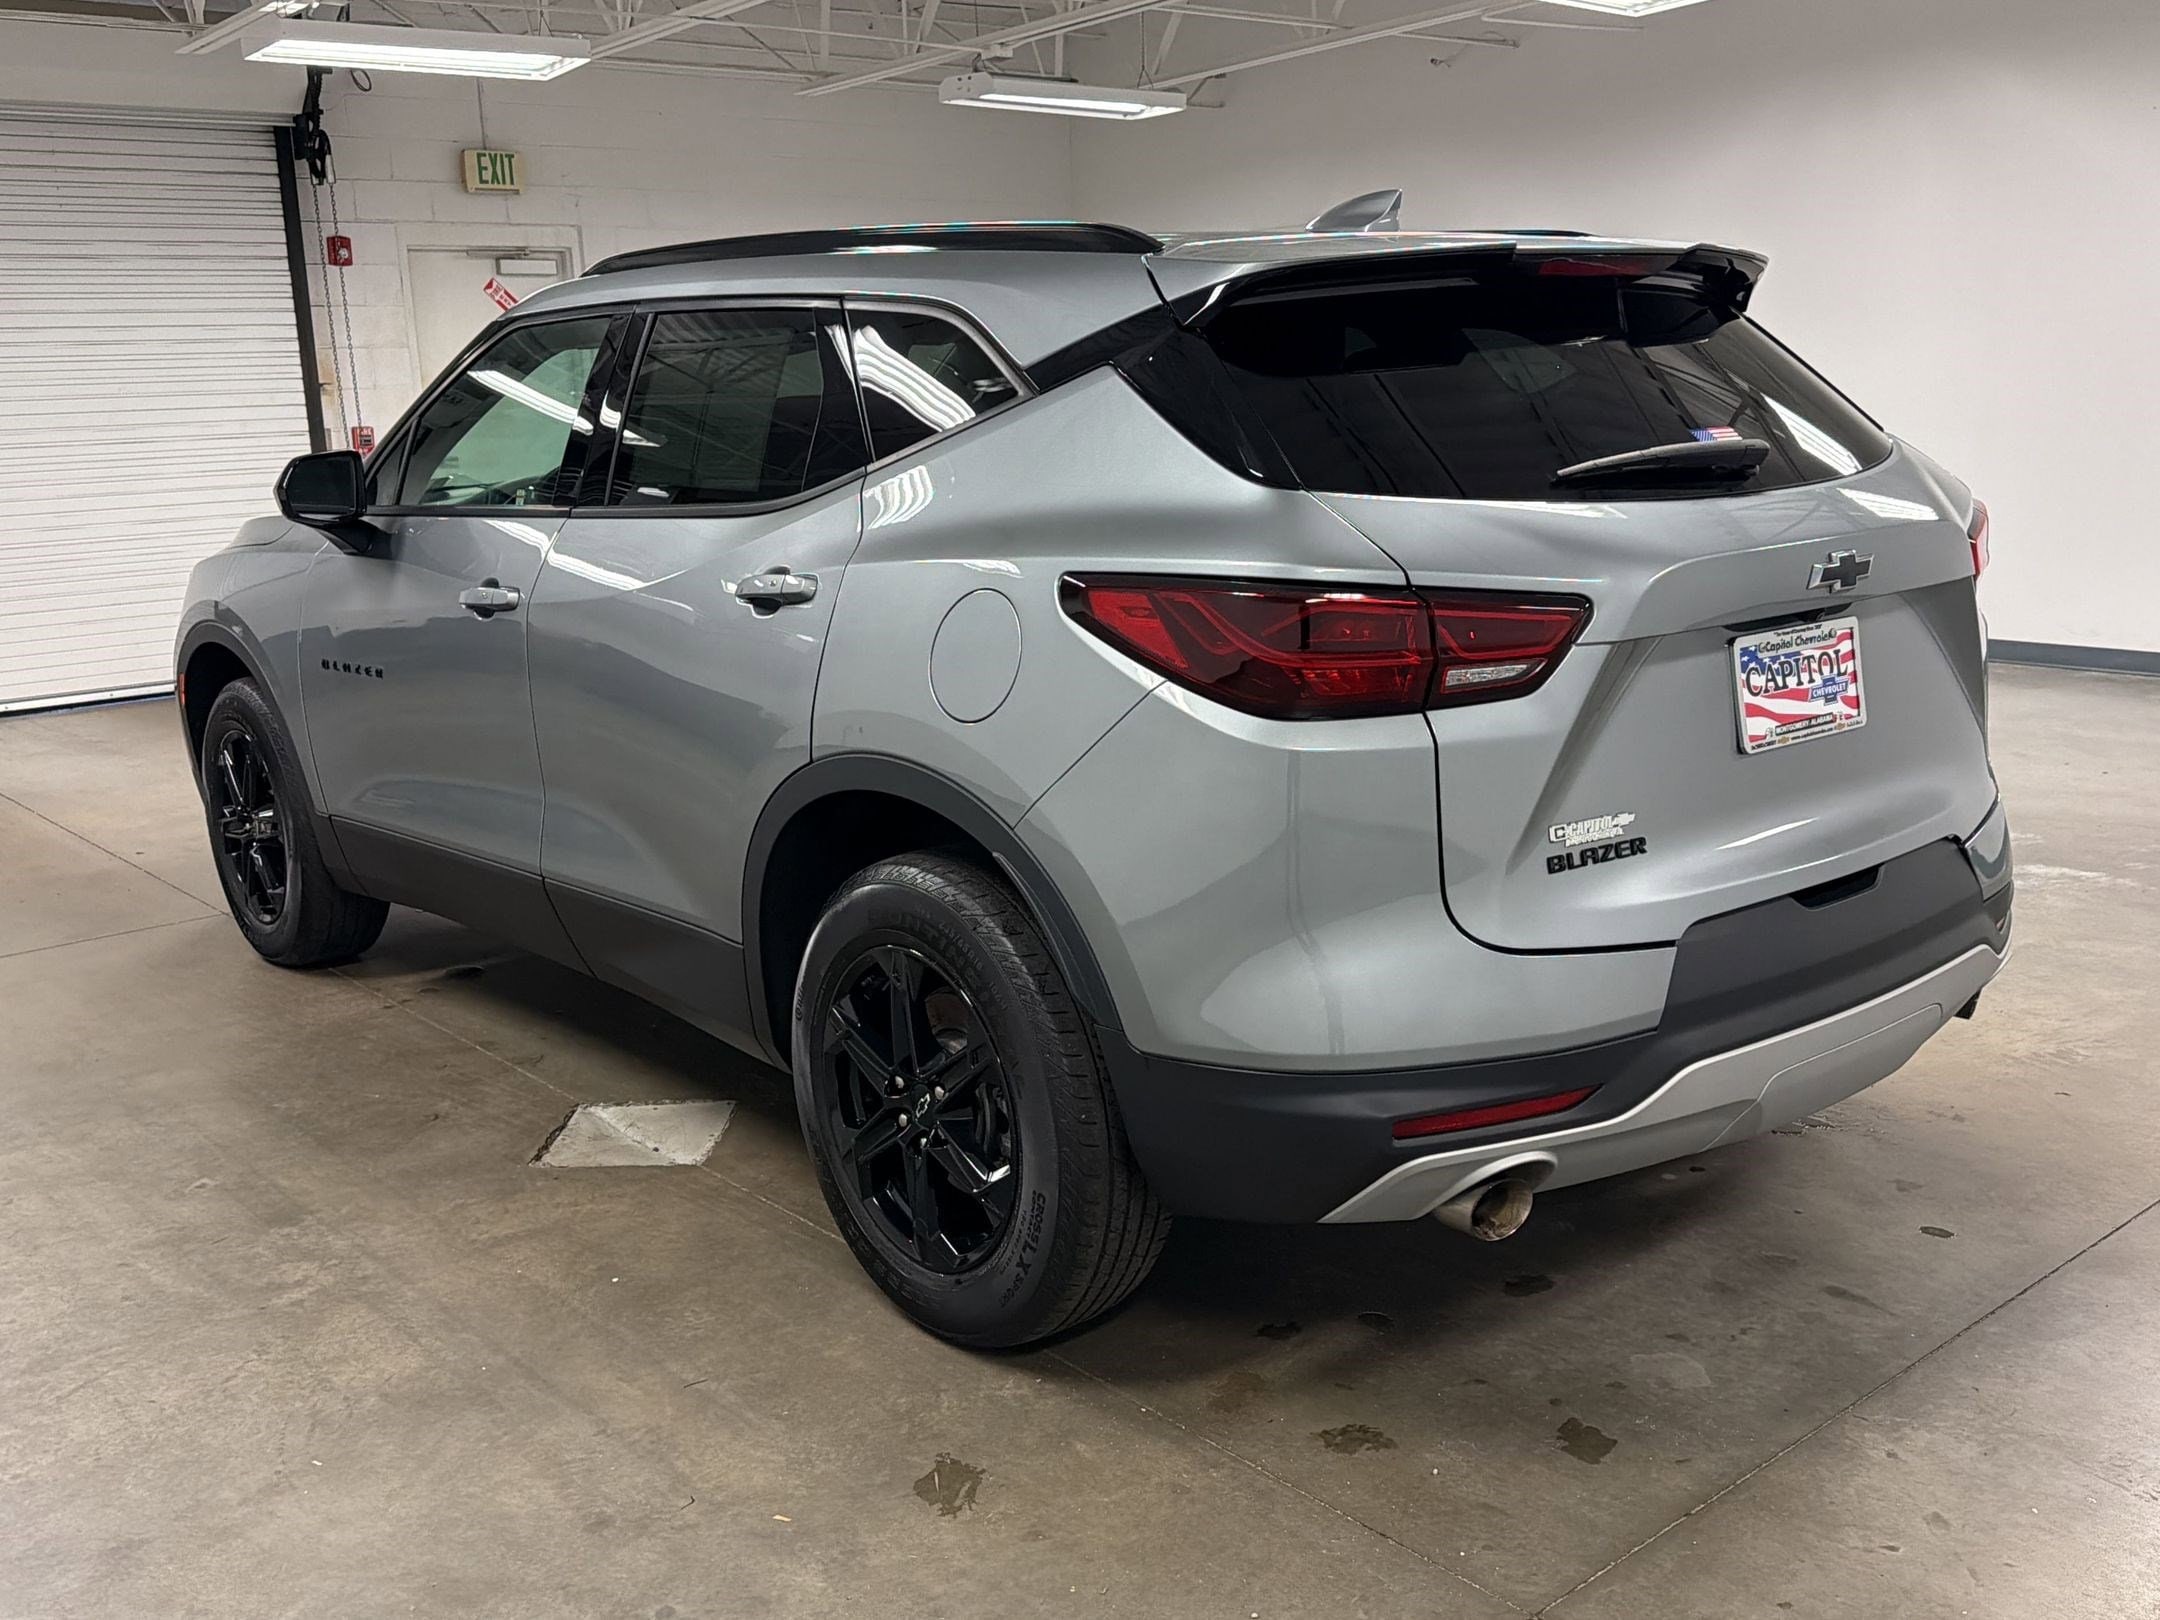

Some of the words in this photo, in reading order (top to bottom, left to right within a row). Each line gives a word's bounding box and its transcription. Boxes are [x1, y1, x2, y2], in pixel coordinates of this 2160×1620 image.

[476, 152, 515, 185] EXIT
[1765, 637, 1793, 653] Capitol
[321, 659, 383, 679] BLAZER
[1745, 648, 1848, 697] CAPITOL
[1812, 683, 1847, 697] CHEVROLET
[1570, 815, 1613, 836] CAPITOL
[1547, 837, 1647, 874] BLAZER
[1025, 1189, 1037, 1239] CONTACT
[1030, 1192, 1046, 1247] CROSS
[998, 1272, 1024, 1308] SPORT
